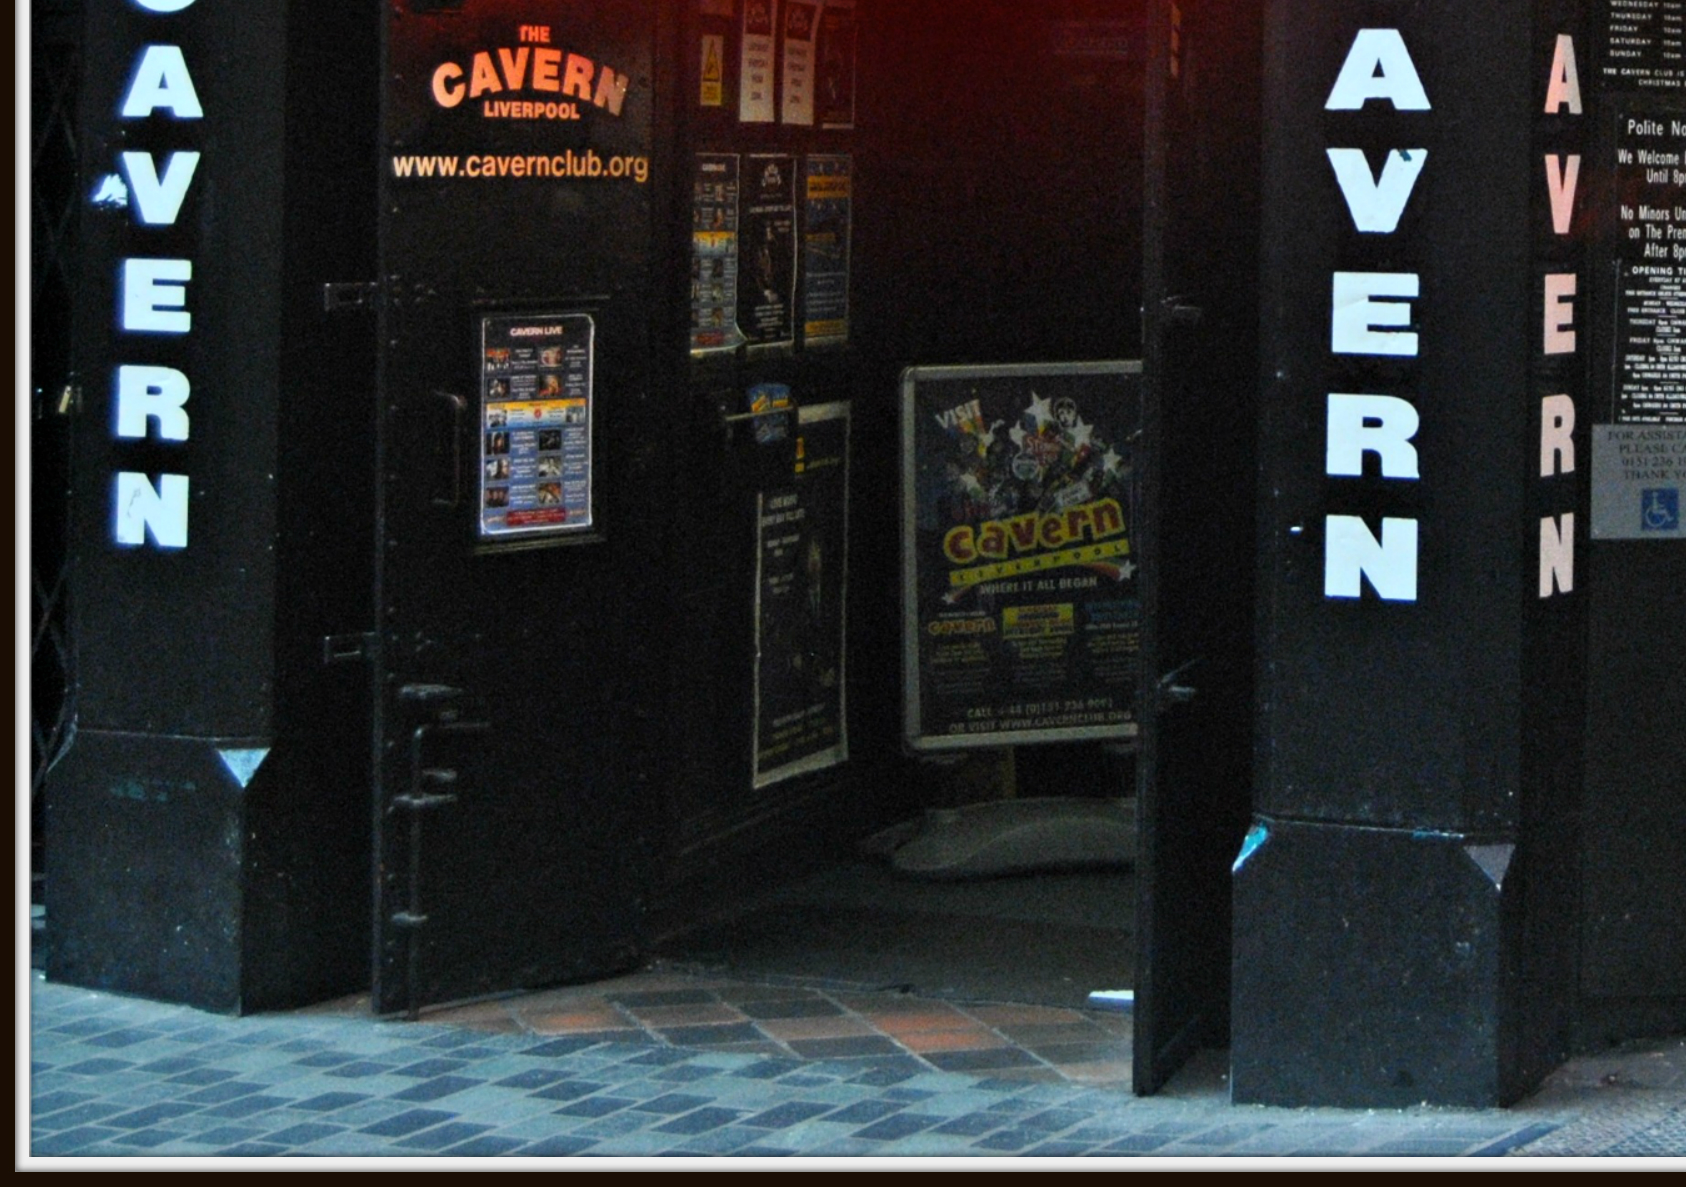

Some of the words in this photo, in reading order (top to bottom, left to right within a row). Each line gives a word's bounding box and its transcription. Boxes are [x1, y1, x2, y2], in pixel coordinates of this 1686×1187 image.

[1610, 0, 1659, 8] WEDNESDAY
[1610, 11, 1653, 21] THURSDAY
[519, 25, 550, 42] THE
[1609, 24, 1638, 33] FRIDAY
[1609, 37, 1652, 46] SATURDAY
[1609, 49, 1642, 58] SUNDAY
[1620, 67, 1651, 76] CAVERN
[1653, 68, 1674, 77] CLUB
[432, 47, 629, 116] CAVERN
[1638, 79, 1681, 87] CHRISTMAS
[484, 100, 580, 119] LIVERPOOL
[1627, 118, 1664, 136] Polite
[1617, 148, 1634, 164] We
[1637, 148, 1680, 165] Welcome
[393, 149, 648, 182] www.cavernclub.org
[1645, 168, 1669, 184] Until
[1620, 205, 1634, 221] No
[1638, 205, 1671, 221] Minors
[1628, 226, 1641, 240] on
[1645, 223, 1663, 240] The
[1643, 242, 1669, 258] After
[1632, 266, 1673, 276] OPENING
[544, 326, 563, 335] LIVE
[935, 398, 982, 430] VISIT
[1608, 430, 1634, 441] FOR
[1619, 444, 1666, 454] PLEASE
[1621, 456, 1650, 467] 0151
[1623, 469, 1669, 480] THANK
[943, 496, 1127, 564] cavern
[1038, 578, 1057, 590] ALL
